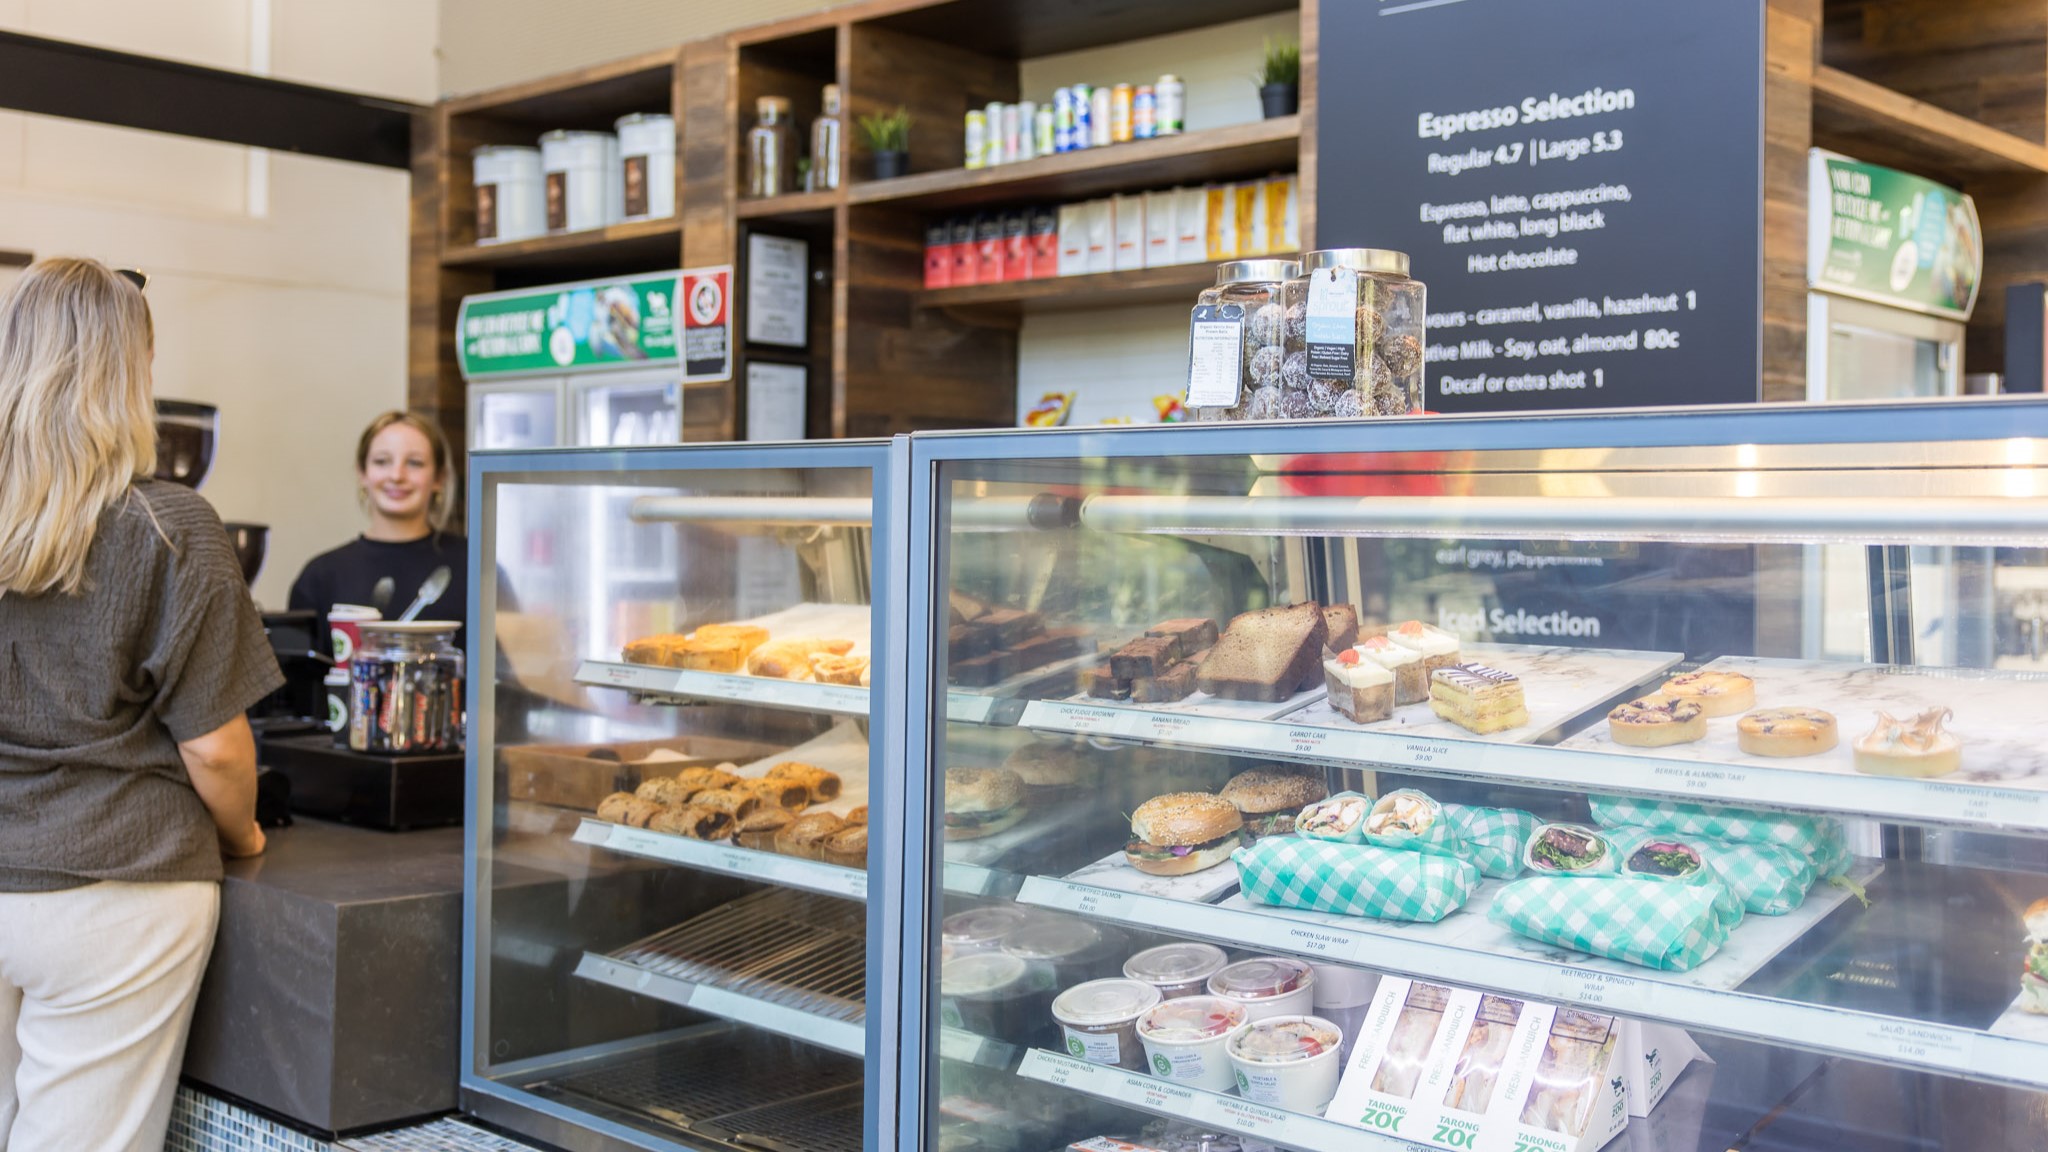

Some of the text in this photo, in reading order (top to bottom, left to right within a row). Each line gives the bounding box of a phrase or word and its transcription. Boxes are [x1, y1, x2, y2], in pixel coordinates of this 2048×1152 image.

[1418, 87, 1635, 141] Espresso Selection
[1428, 148, 1494, 175] Regular
[1494, 142, 1524, 165] 4.7
[1539, 137, 1591, 161] Large
[1592, 129, 1623, 153] 5.3
[1420, 183, 1632, 224] Espresso, latte, cappuccino,
[1443, 208, 1606, 244] flat white, long black
[1467, 246, 1578, 274] Hot chocolate
[1425, 311, 1466, 328] vours
[1475, 301, 1543, 325] caramel,
[1544, 298, 1602, 320] vanilla,
[1603, 292, 1679, 315] hazelnut
[1685, 289, 1697, 311] 1
[1460, 340, 1494, 359] Milk
[1504, 337, 1538, 360] Soy,
[1538, 336, 1571, 356] oat,
[1572, 329, 1638, 354] almond
[1643, 328, 1681, 350] 80c
[1440, 368, 1604, 395] Decaf or extra shot 1
[1438, 606, 1601, 638] Iced Selection
[1406, 744, 1431, 752] VANILLA
[1415, 754, 1432, 762] $9.00
[1655, 767, 1682, 776] BERRIES
[1692, 770, 1725, 779] ALMOND
[1728, 772, 1745, 781] TART
[1291, 929, 1349, 944] CHICKEN SLAW WRAP
[1561, 969, 1596, 980] BEETROOT
[1605, 976, 1635, 986] SPINACH
[1584, 983, 1604, 991] WRAP
[1579, 992, 1603, 1001] $14.00
[1374, 991, 1397, 1037] ANDWICH
[1443, 1005, 1466, 1048] ANDWICH
[1881, 1024, 1905, 1034] SALAD
[1907, 1028, 1952, 1041] SANDWICH
[1520, 1016, 1542, 1062] ANDWICH
[1037, 1054, 1095, 1073] CHICKEN MUSTARD PASTA
[1054, 1067, 1069, 1075] SALAD
[1126, 1078, 1142, 1087] ASIAN
[1143, 1082, 1158, 1091] CORN
[1163, 1087, 1192, 1098] CORIANDER
[1145, 1097, 1162, 1106] $10.00
[1216, 1099, 1244, 1111] VEGETABLE
[1249, 1108, 1270, 1117] QUINOA
[1270, 1112, 1286, 1121] SALAD
[1236, 1118, 1255, 1128] $10.00
[1440, 1116, 1479, 1132] TARONG
[1518, 1132, 1567, 1151] TARONGA
